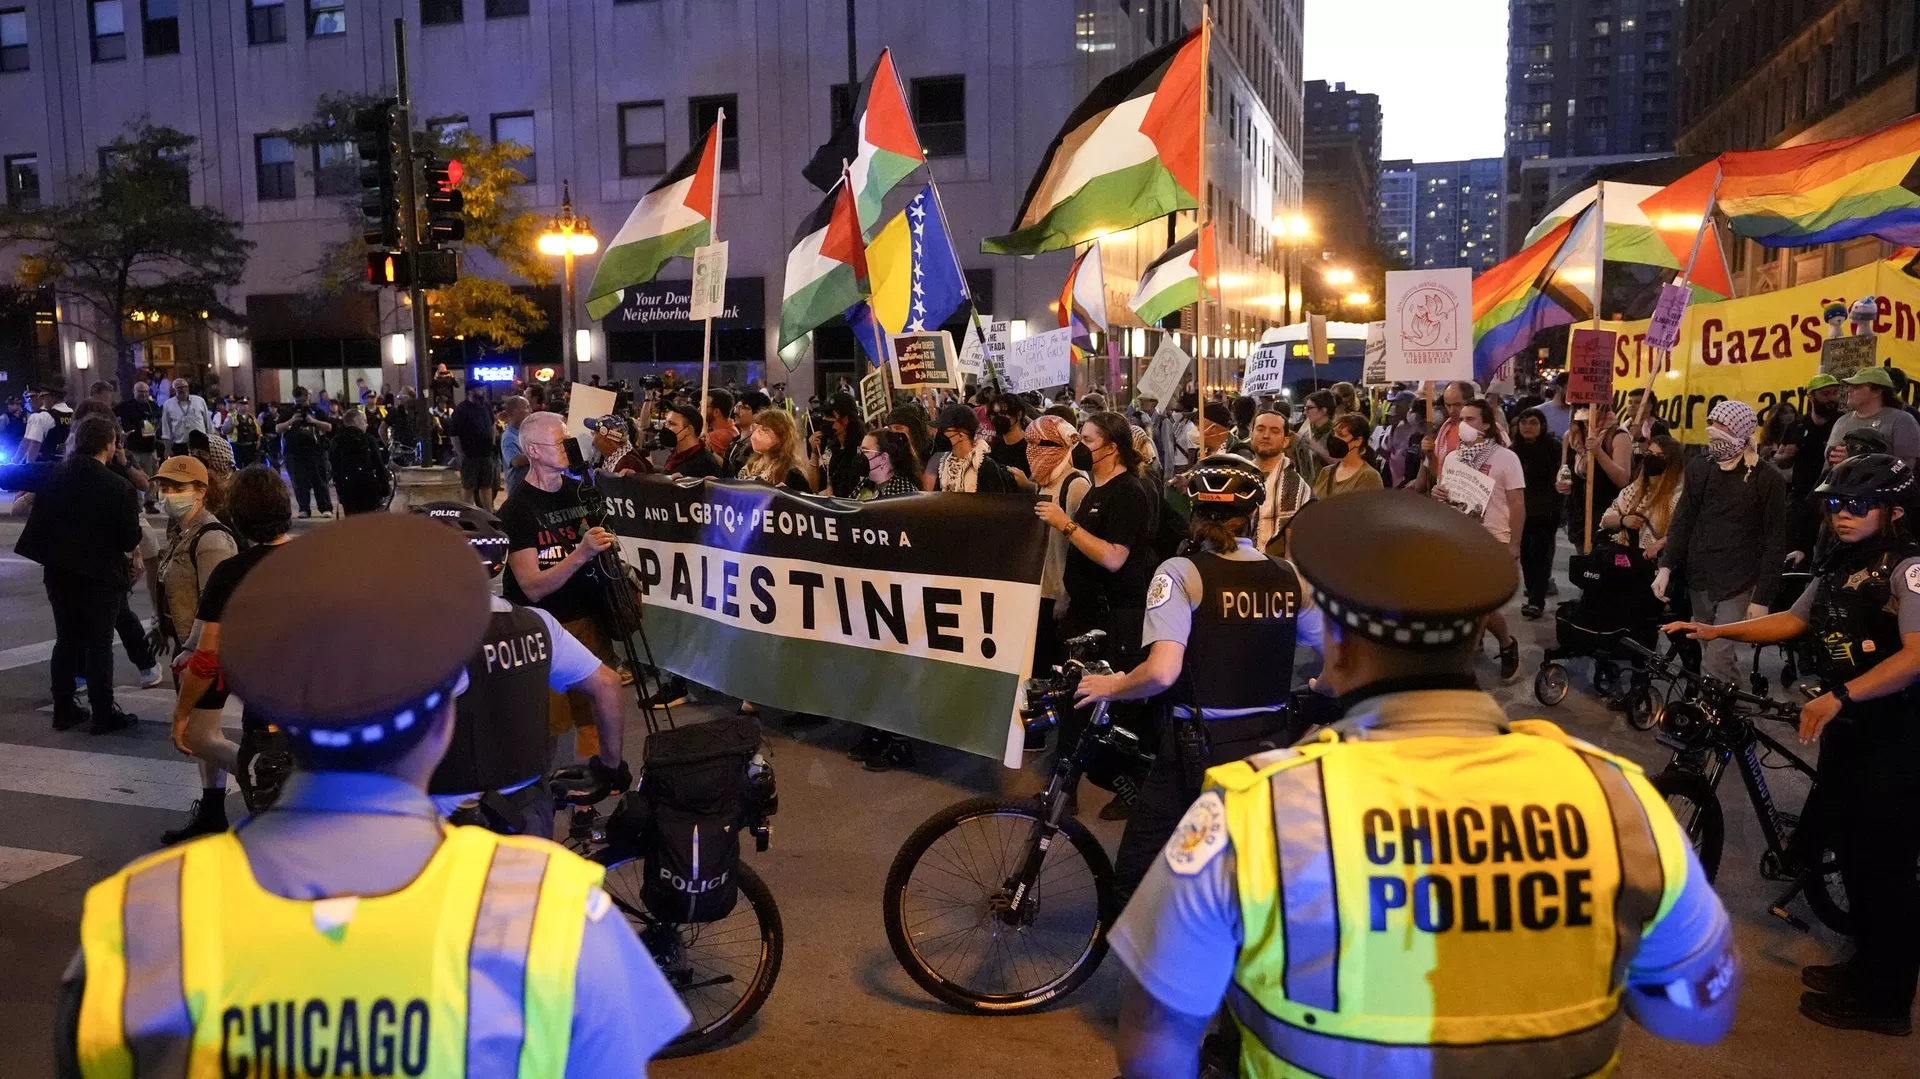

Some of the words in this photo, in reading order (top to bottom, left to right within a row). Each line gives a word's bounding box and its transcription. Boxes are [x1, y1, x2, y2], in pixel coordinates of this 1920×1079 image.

[636, 292, 662, 306] Your
[665, 292, 691, 305] Dow
[623, 307, 691, 323] Neighborho
[990, 323, 1006, 332] ALIZE
[1016, 336, 1046, 356] RIGHTS
[1702, 314, 1822, 366] Gaza's
[1248, 358, 1278, 374] LGBTQ
[1252, 350, 1274, 362] FULL
[1245, 372, 1279, 388] EQUALITY
[1248, 382, 1268, 394] NOW!
[430, 510, 460, 518] POLICE
[606, 497, 636, 519] STS
[645, 509, 669, 522] AND
[676, 502, 744, 534] LGBTQ+
[750, 509, 839, 542] PEOPLE
[852, 528, 889, 547] FOR
[899, 531, 912, 548] A
[638, 548, 997, 660] PALESTINE!
[1222, 591, 1294, 619] POLICE
[483, 632, 547, 674] POLICE
[1744, 743, 1769, 798] CHICAGO
[1112, 775, 1138, 806] CHIC
[1362, 803, 1590, 866] CHICAGO
[1368, 869, 1592, 934] POLICE
[221, 997, 430, 1079] CHICAGO
